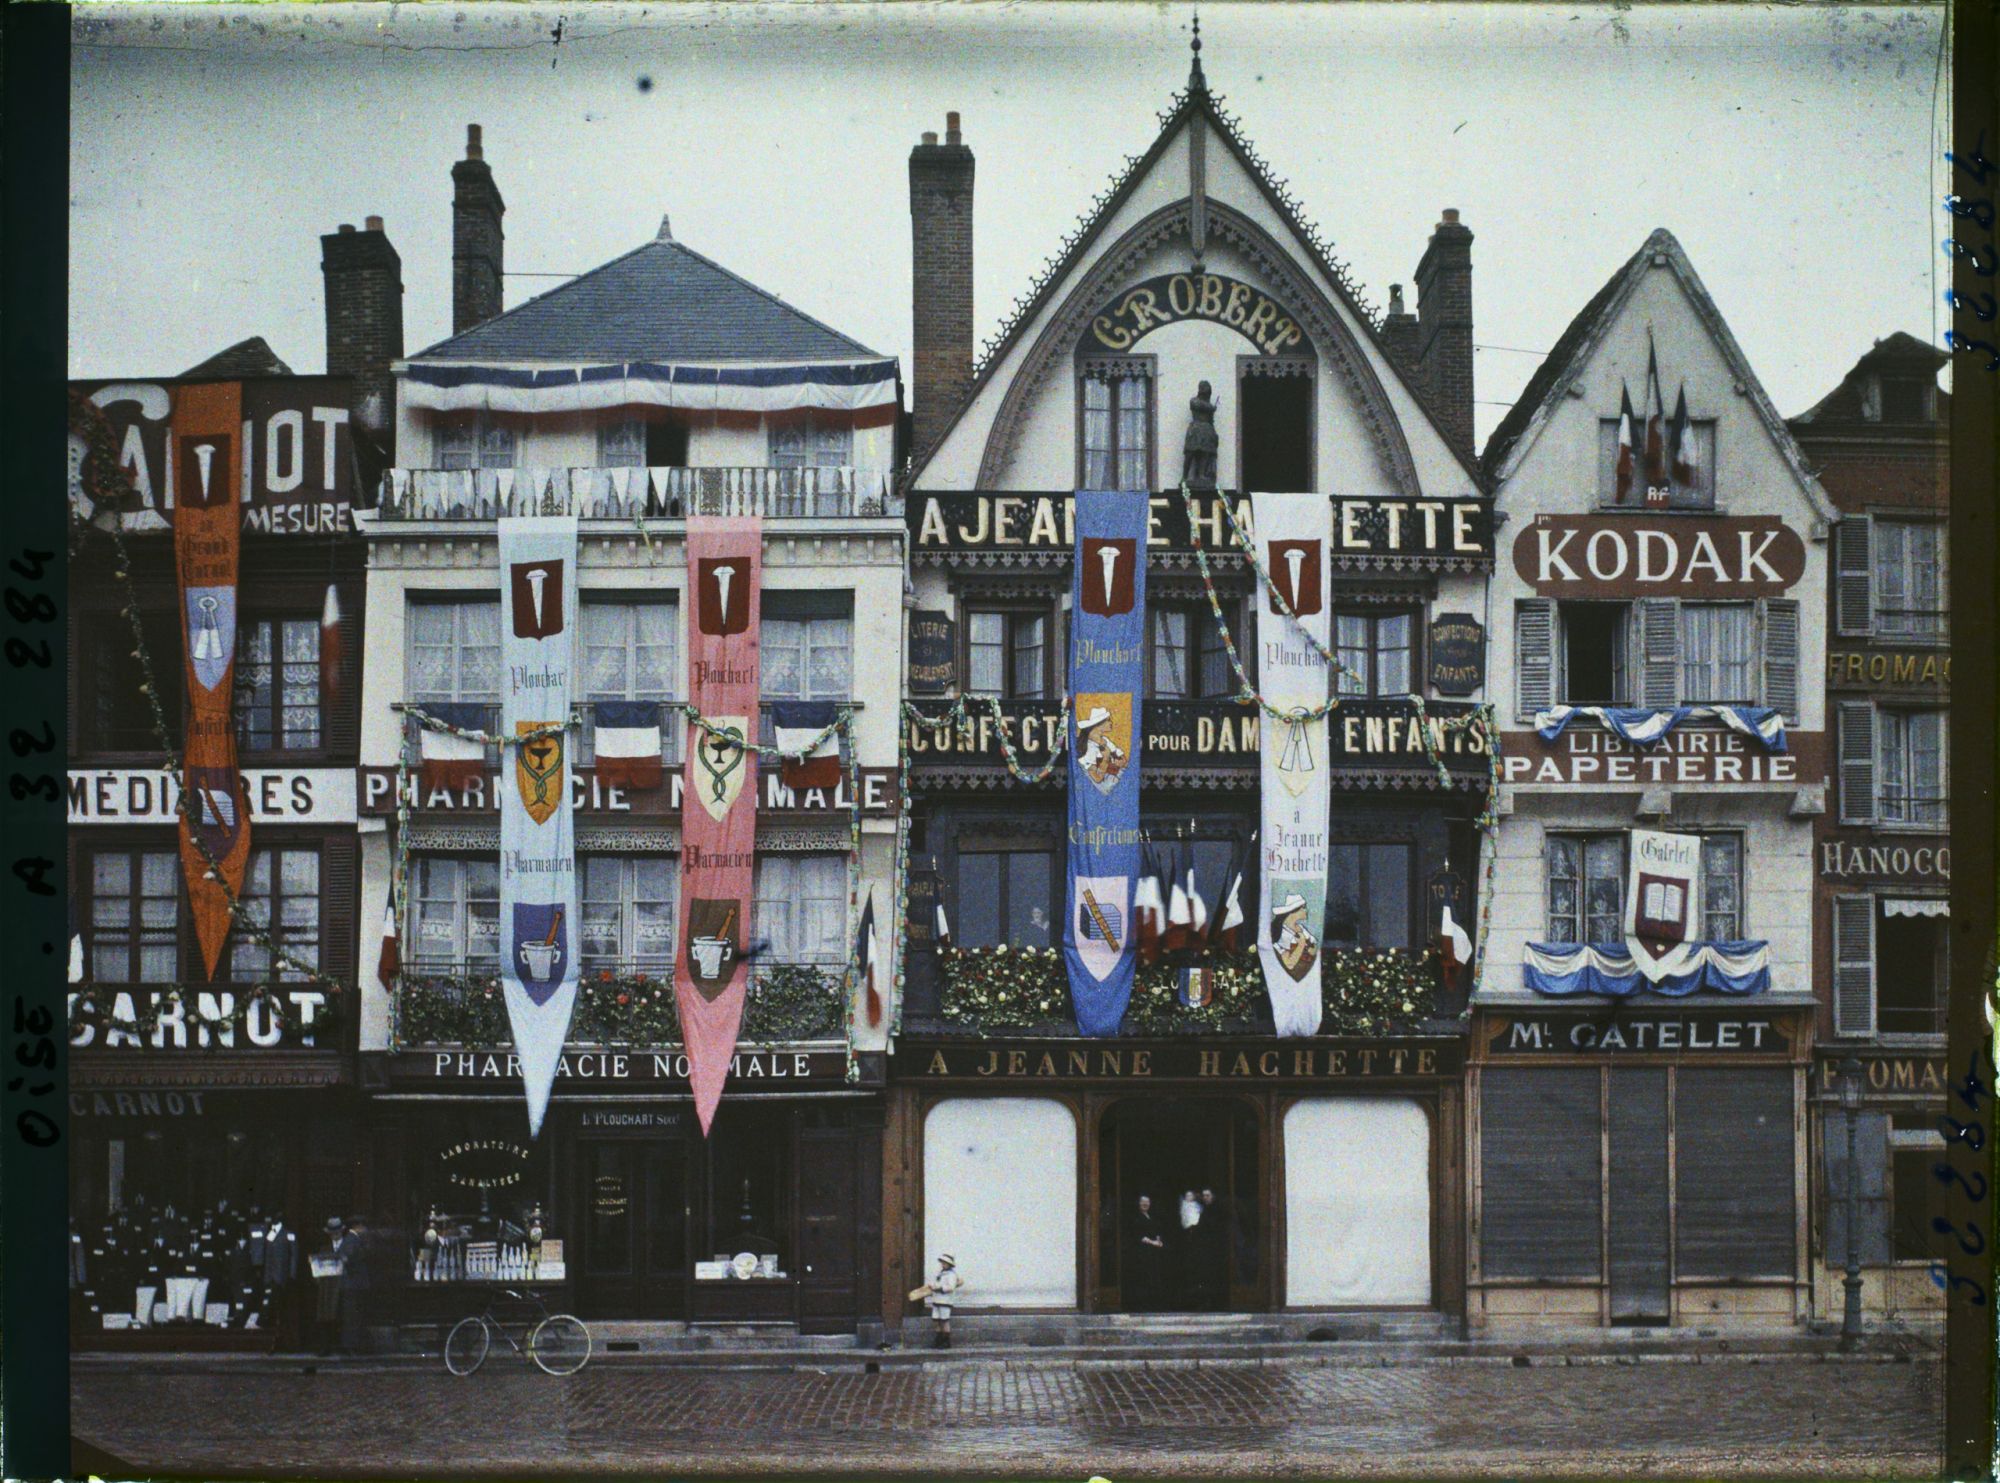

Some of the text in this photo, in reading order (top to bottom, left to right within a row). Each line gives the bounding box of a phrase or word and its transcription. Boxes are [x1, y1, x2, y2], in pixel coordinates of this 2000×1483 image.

[1114, 275, 1301, 355] ROBERT
[243, 502, 350, 533] MESURE
[919, 497, 949, 546] A
[1536, 529, 1784, 583] KODAK
[4, 550, 58, 668] 284
[1149, 735, 1191, 751] POUR
[1503, 756, 1797, 781] PAPETERIE
[1275, 824, 1323, 847] Jeanne
[928, 1050, 1437, 1076] A JEANNE HACHETTE
[69, 1091, 205, 1116] CARNOT
[593, 1111, 654, 1126] PLOUCHART
[440, 1140, 529, 1160] LABORATOIRE
